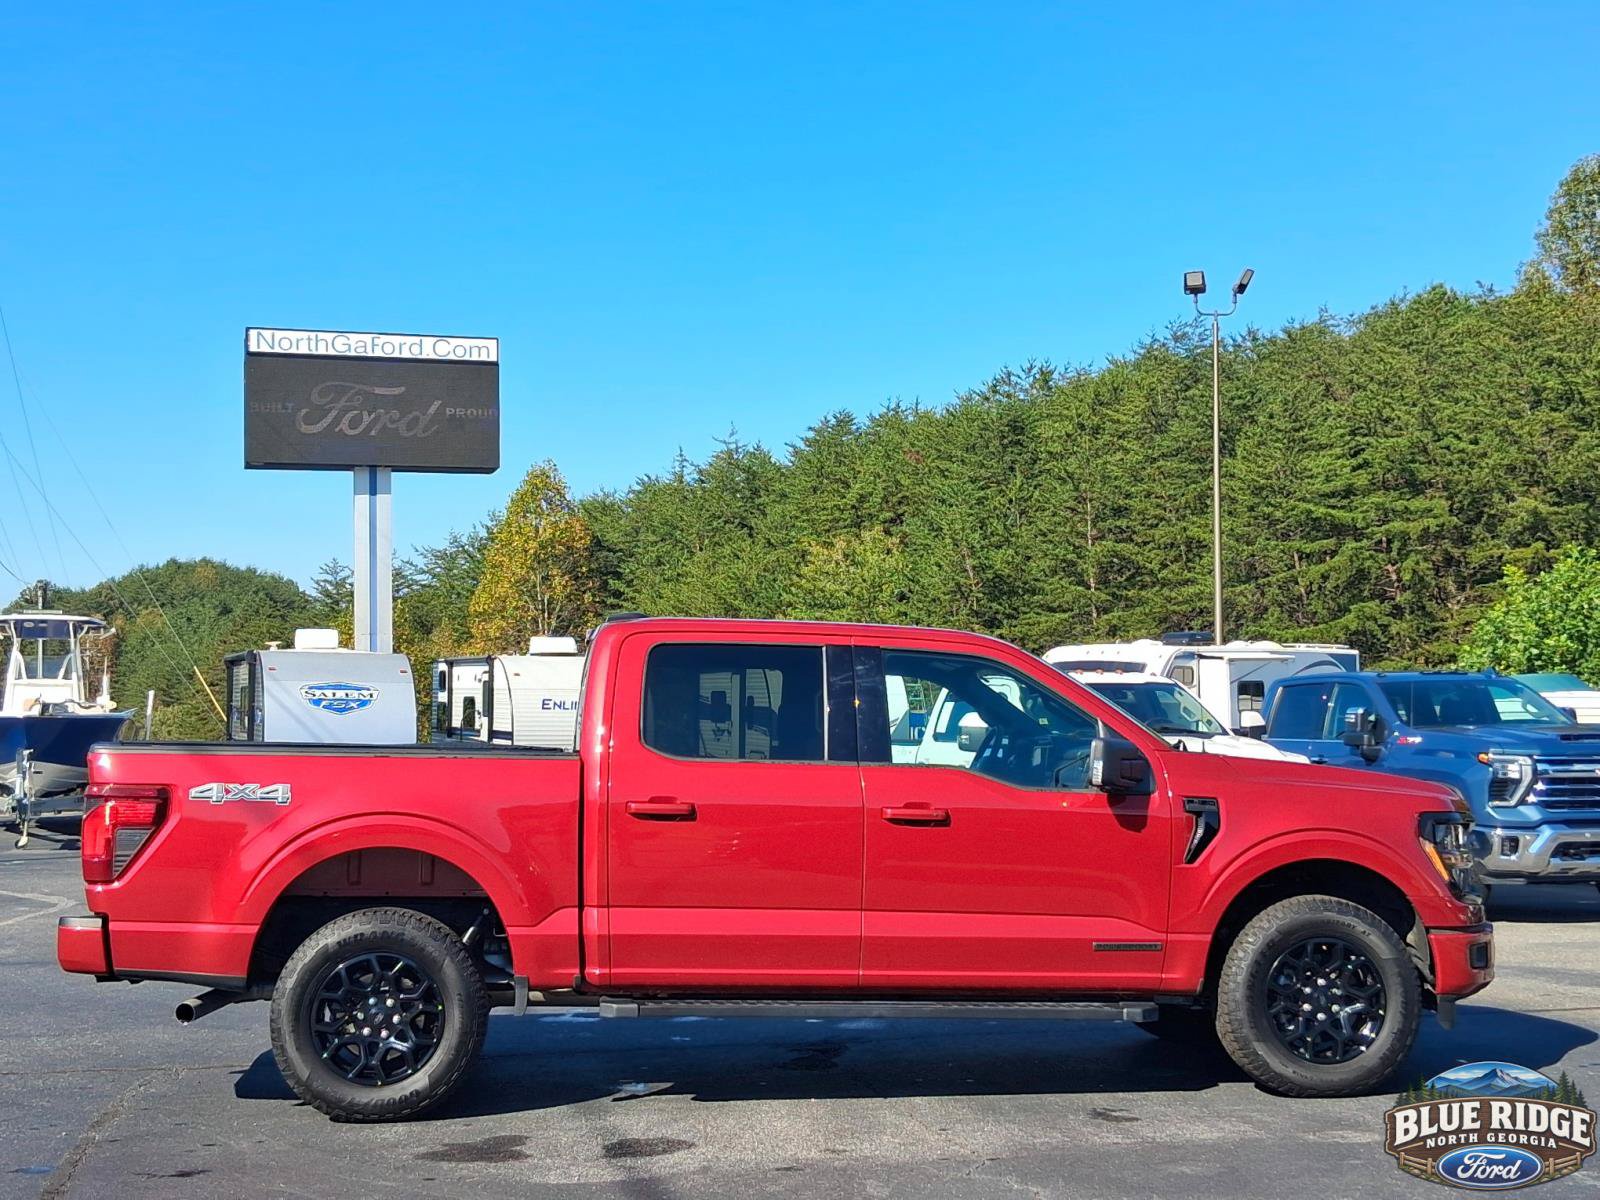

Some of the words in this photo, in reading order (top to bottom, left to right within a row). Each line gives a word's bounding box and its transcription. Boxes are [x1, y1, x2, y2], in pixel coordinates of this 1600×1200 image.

[255, 330, 490, 360] NorthGaFord.Com
[296, 381, 442, 437] Ford
[303, 689, 374, 699] SALEM
[541, 698, 578, 710] ENLI
